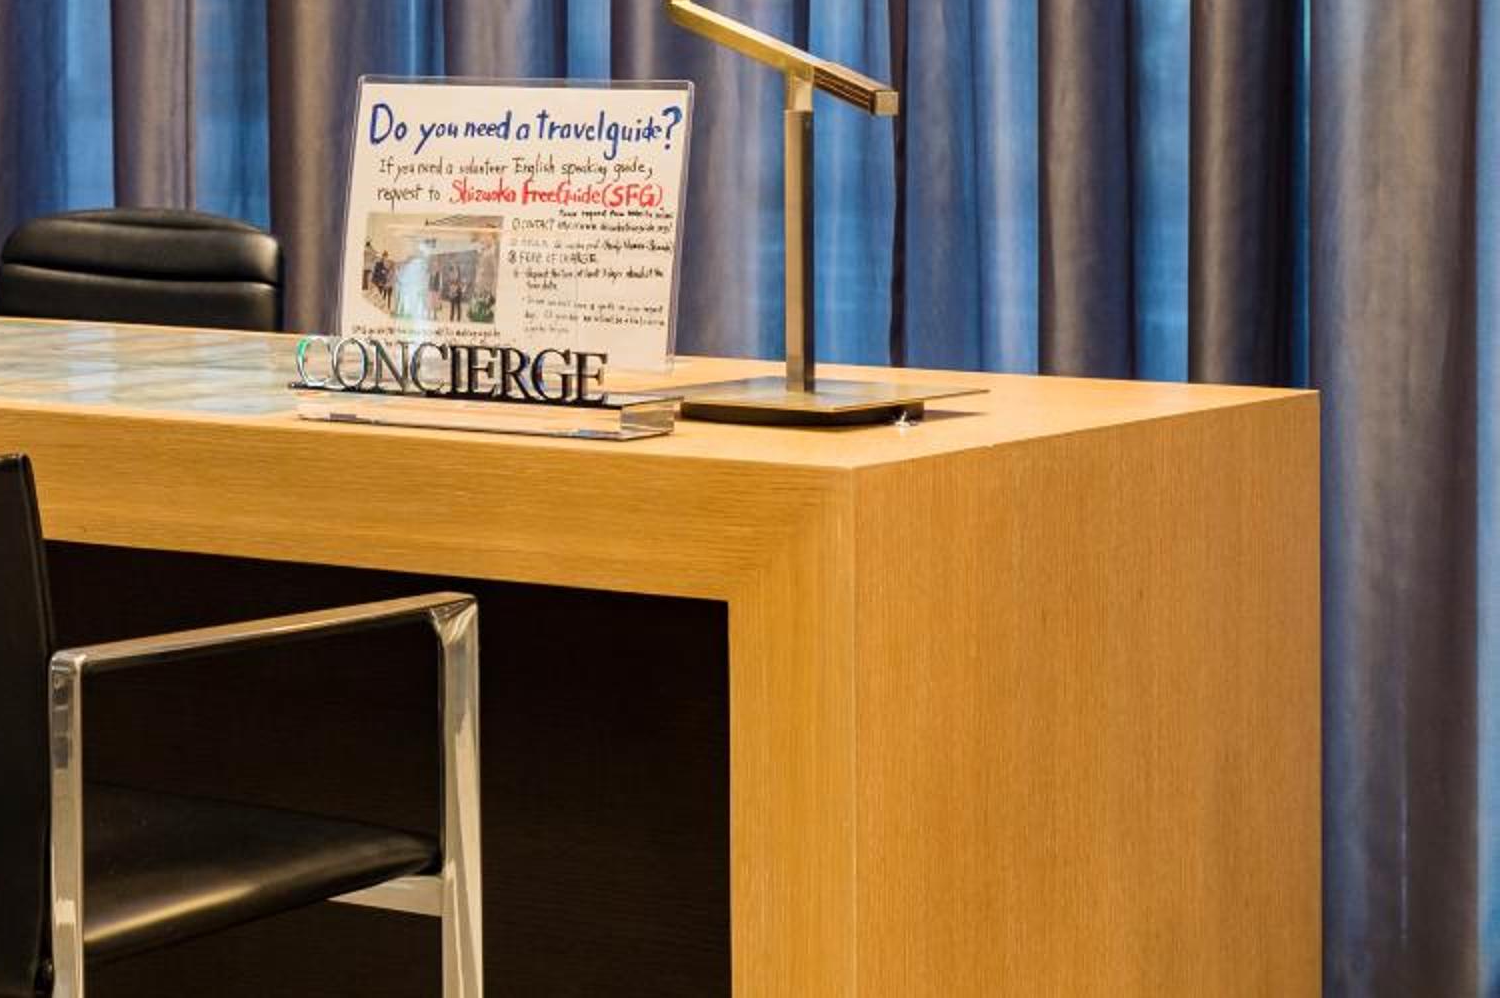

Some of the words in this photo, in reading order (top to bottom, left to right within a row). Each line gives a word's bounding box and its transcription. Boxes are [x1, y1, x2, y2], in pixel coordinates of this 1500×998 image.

[370, 103, 407, 145] Do
[414, 122, 459, 155] you
[463, 110, 512, 140] need
[515, 123, 531, 140] a
[417, 156, 443, 175] need
[511, 153, 555, 180] English
[377, 183, 423, 211] request
[428, 186, 441, 201] to
[450, 177, 516, 203] Shizuoka
[296, 334, 609, 403] CONCIERGE
